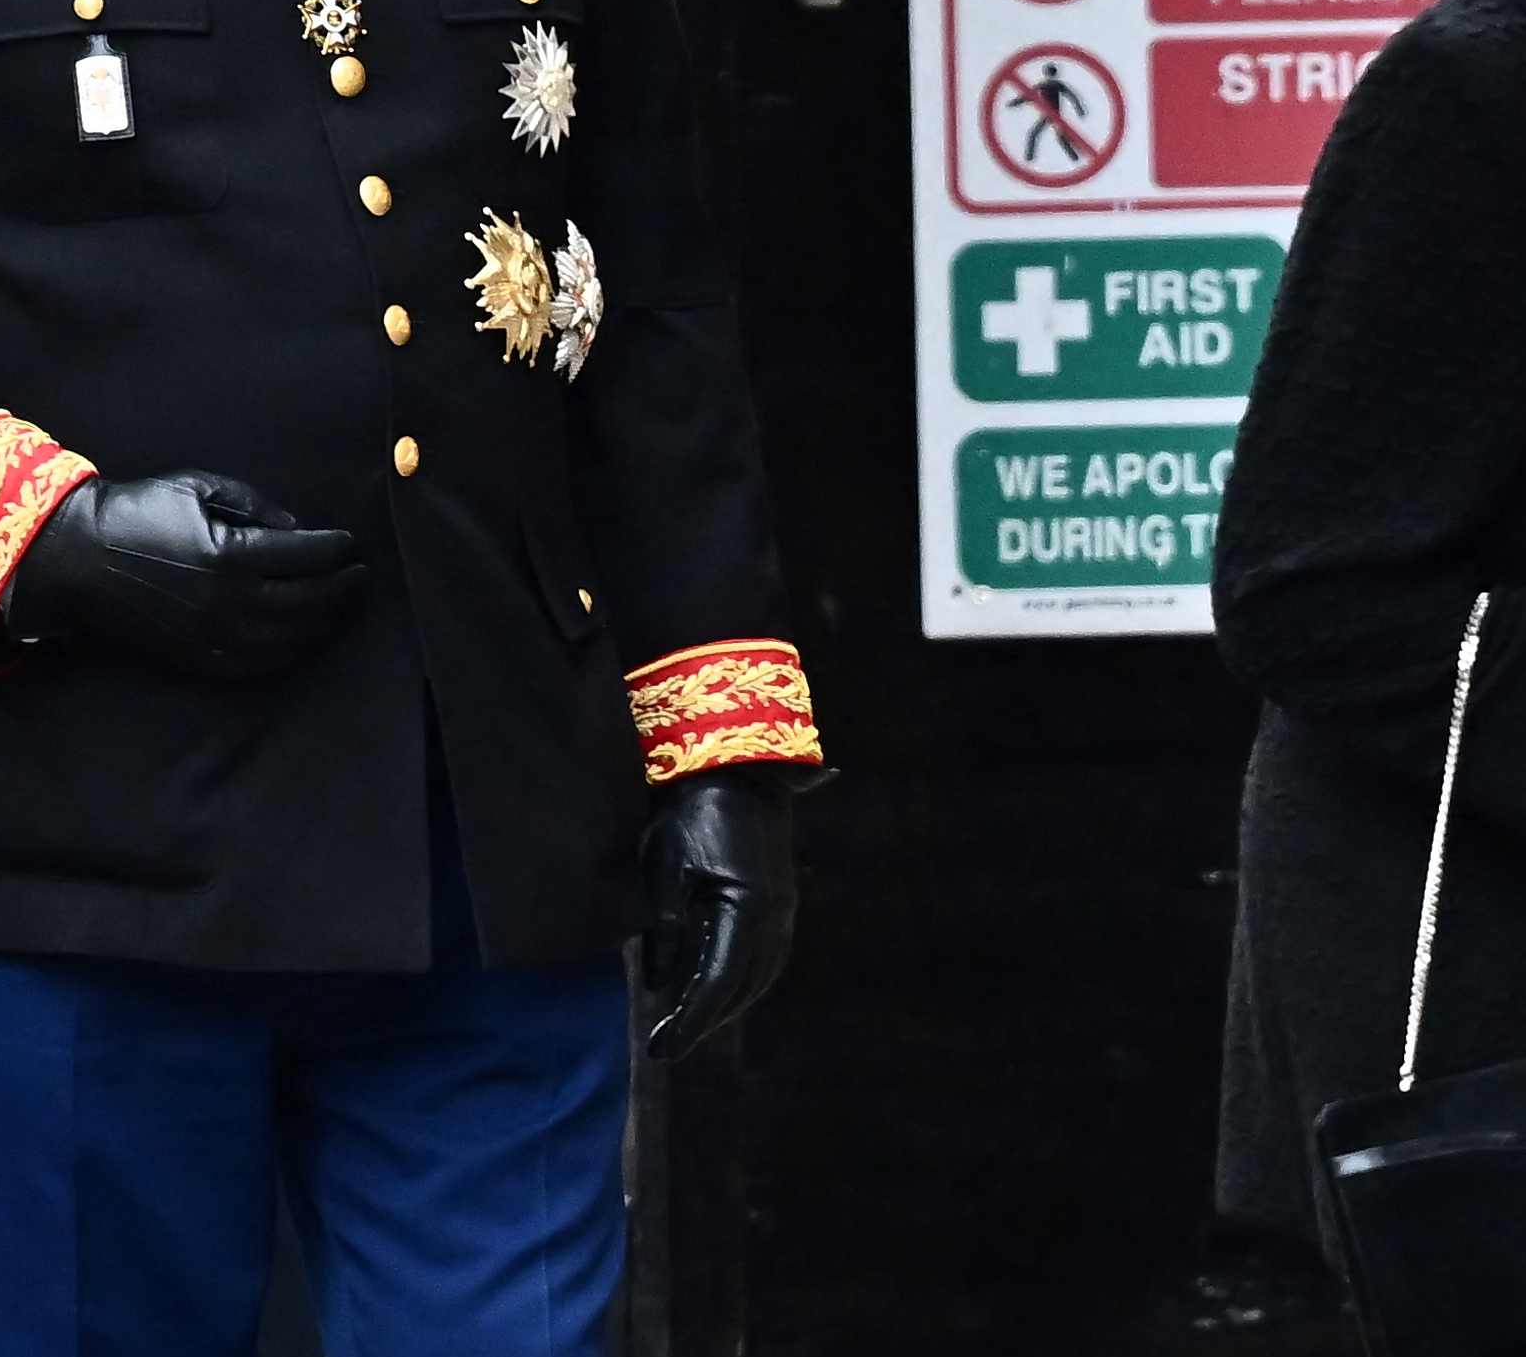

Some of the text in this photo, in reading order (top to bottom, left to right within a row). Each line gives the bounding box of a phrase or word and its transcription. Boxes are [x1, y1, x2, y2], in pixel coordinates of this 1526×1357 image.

[1103, 267, 1262, 316] FIRST
[1138, 320, 1233, 368] AID
[995, 453, 1073, 502] WE
[997, 513, 1177, 565] DURING
